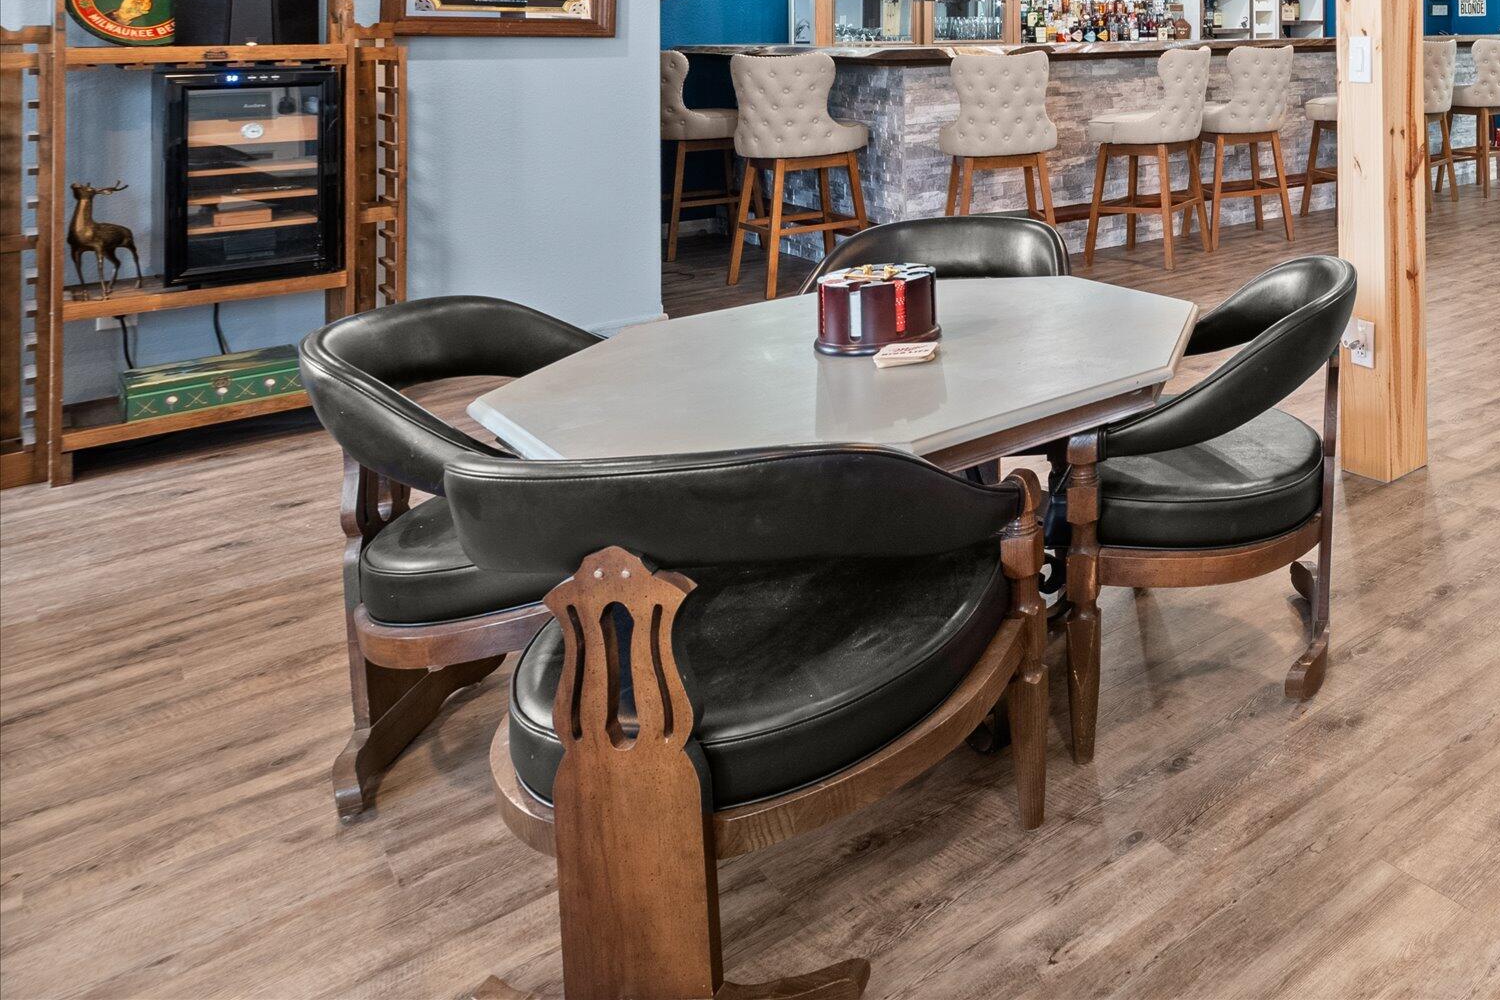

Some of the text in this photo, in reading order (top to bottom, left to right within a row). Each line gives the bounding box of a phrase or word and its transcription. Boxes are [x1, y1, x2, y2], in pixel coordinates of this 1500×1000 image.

[1460, 3, 1485, 14] BLONDE
[88, 13, 176, 38] MILWAUKEE BE
